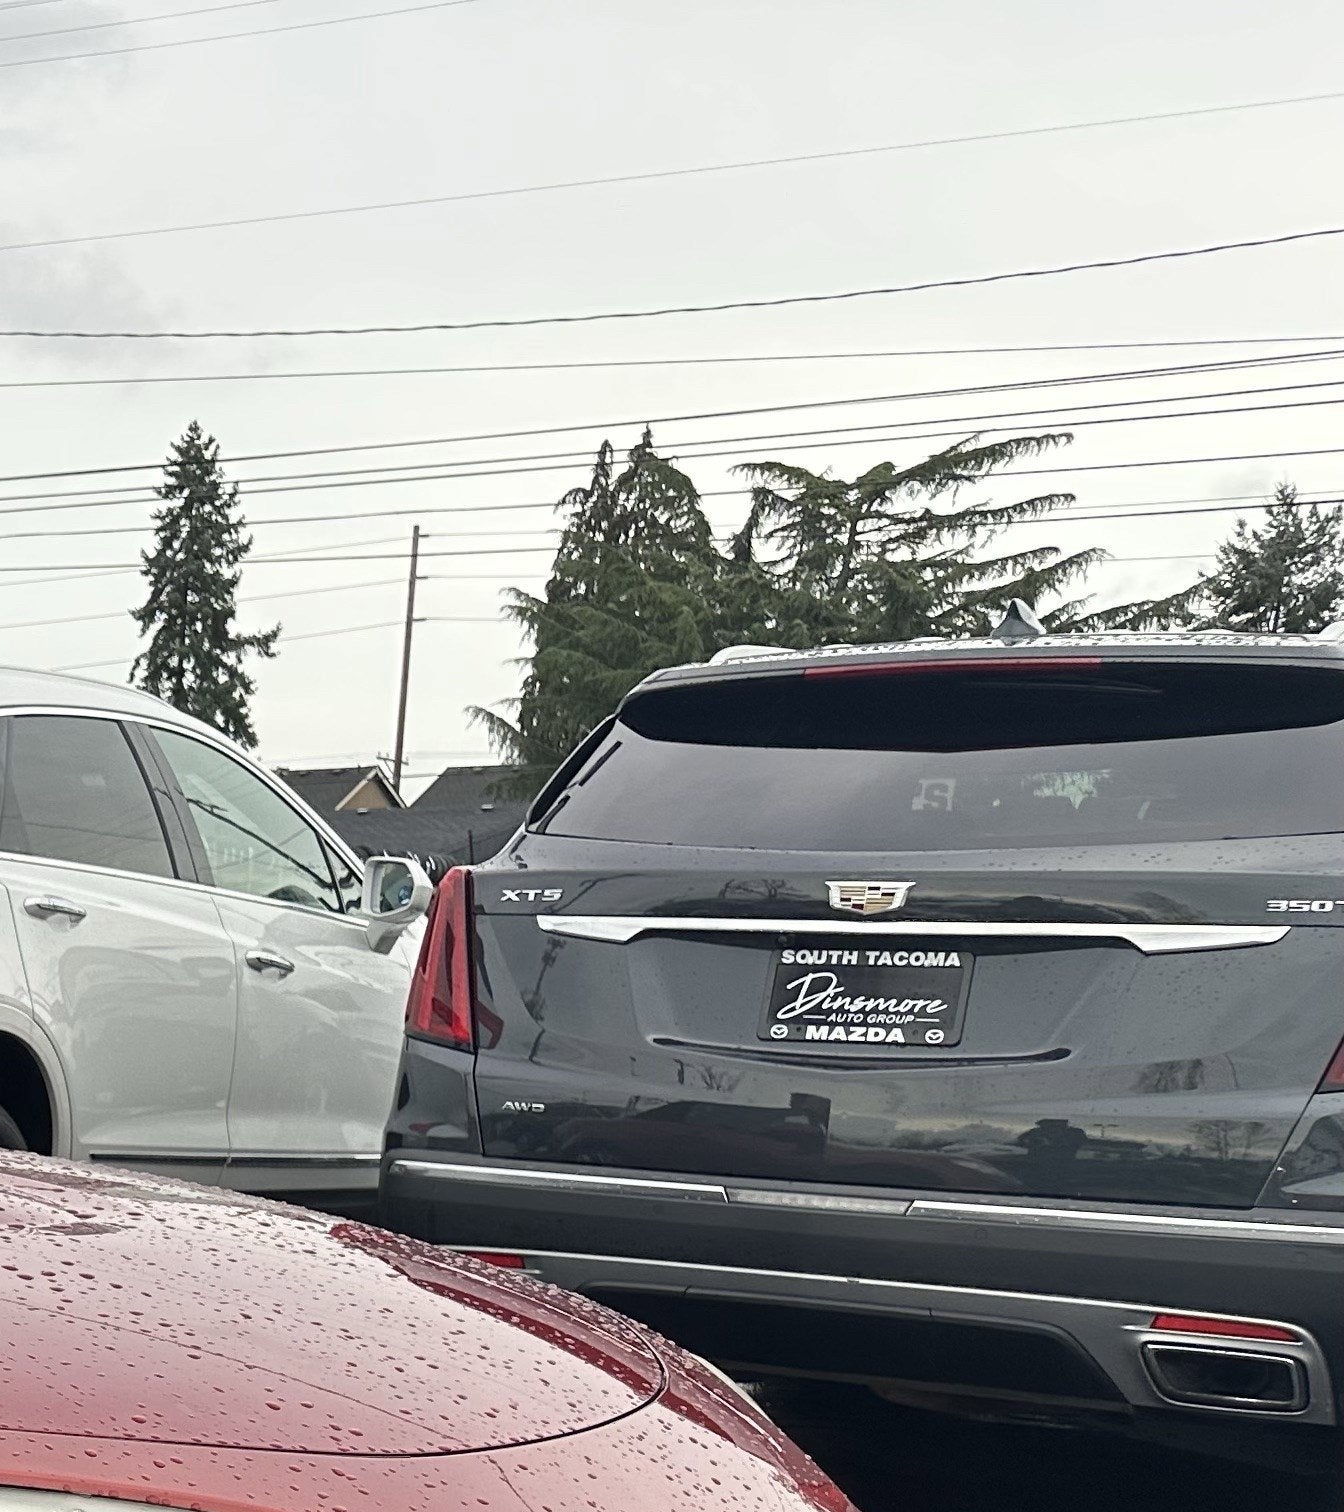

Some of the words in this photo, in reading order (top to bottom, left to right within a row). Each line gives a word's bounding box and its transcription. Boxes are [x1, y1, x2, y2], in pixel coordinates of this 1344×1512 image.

[781, 950, 858, 966] SOUTH
[866, 951, 961, 967] TACOMA
[776, 971, 948, 1019] Dinsmore
[827, 1012, 864, 1023] AUTO
[867, 1013, 915, 1024] GROUP
[805, 1024, 906, 1043] MAZDA
[501, 1101, 545, 1113] AWD
